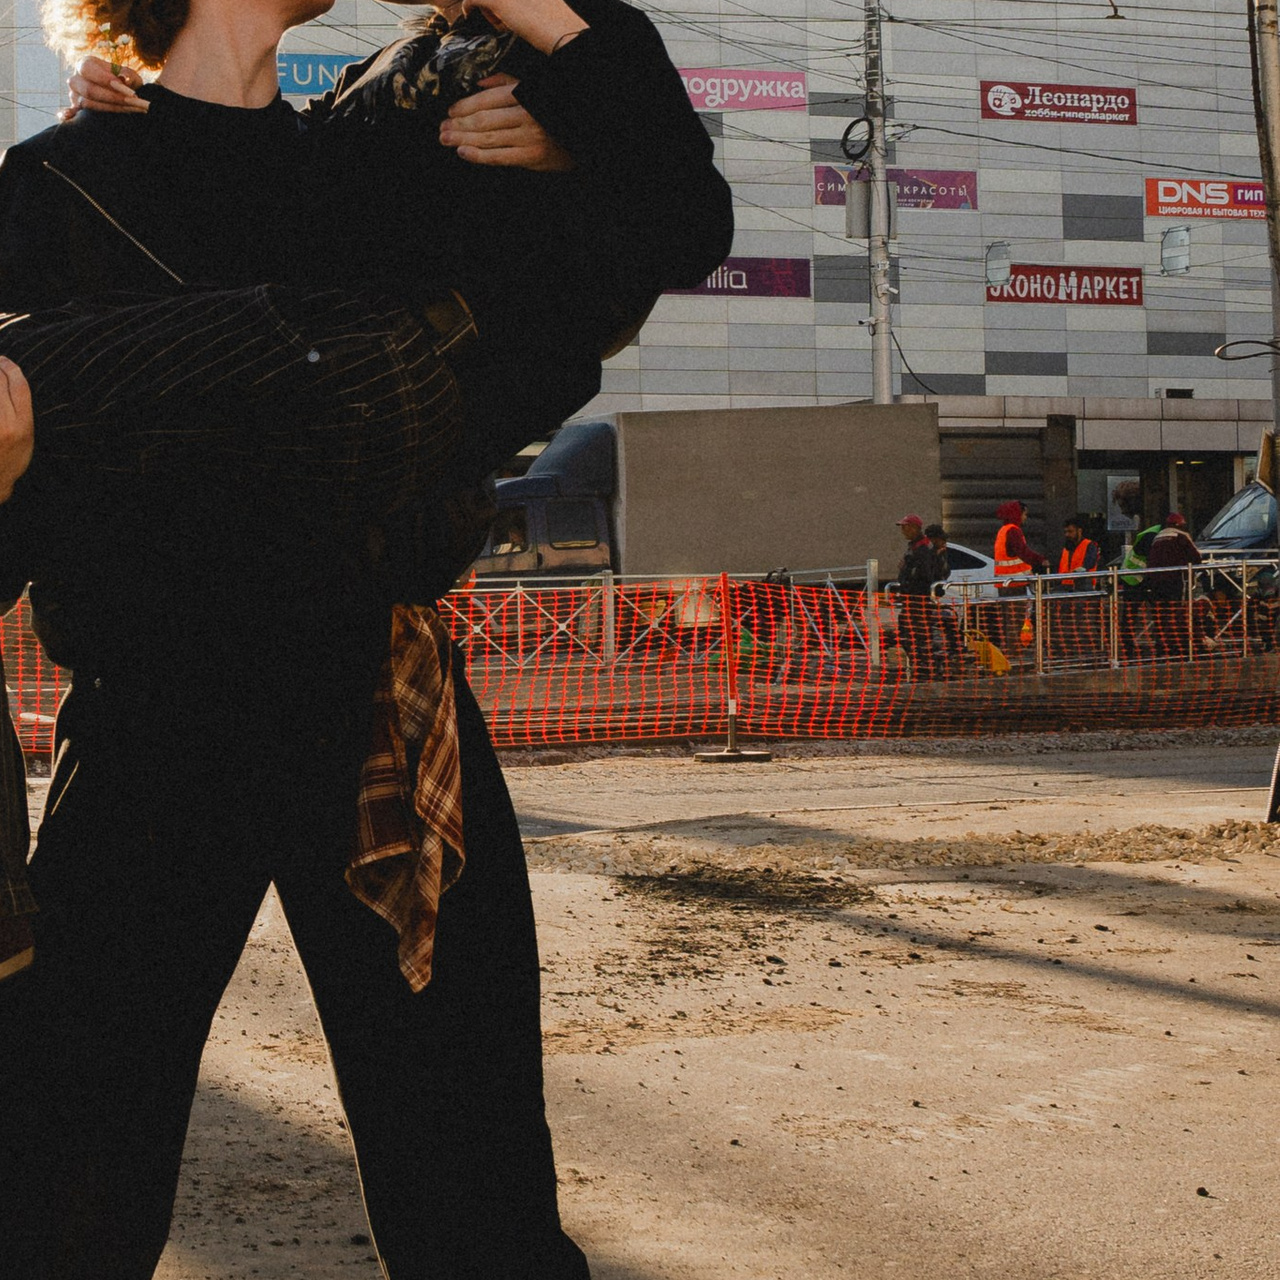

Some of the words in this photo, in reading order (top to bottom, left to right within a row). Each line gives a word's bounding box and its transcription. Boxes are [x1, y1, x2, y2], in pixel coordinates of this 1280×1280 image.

[1024, 86, 1130, 112] Леонардо
[1024, 108, 1130, 122] хобби-гипермаркет
[903, 185, 968, 197] КРАСОТЫ
[1158, 180, 1230, 205] DNS
[1158, 206, 1202, 215] ЦИФРОВАЯ
[1204, 207, 1211, 216] И
[1212, 208, 1248, 217] БЫТОВАЯ
